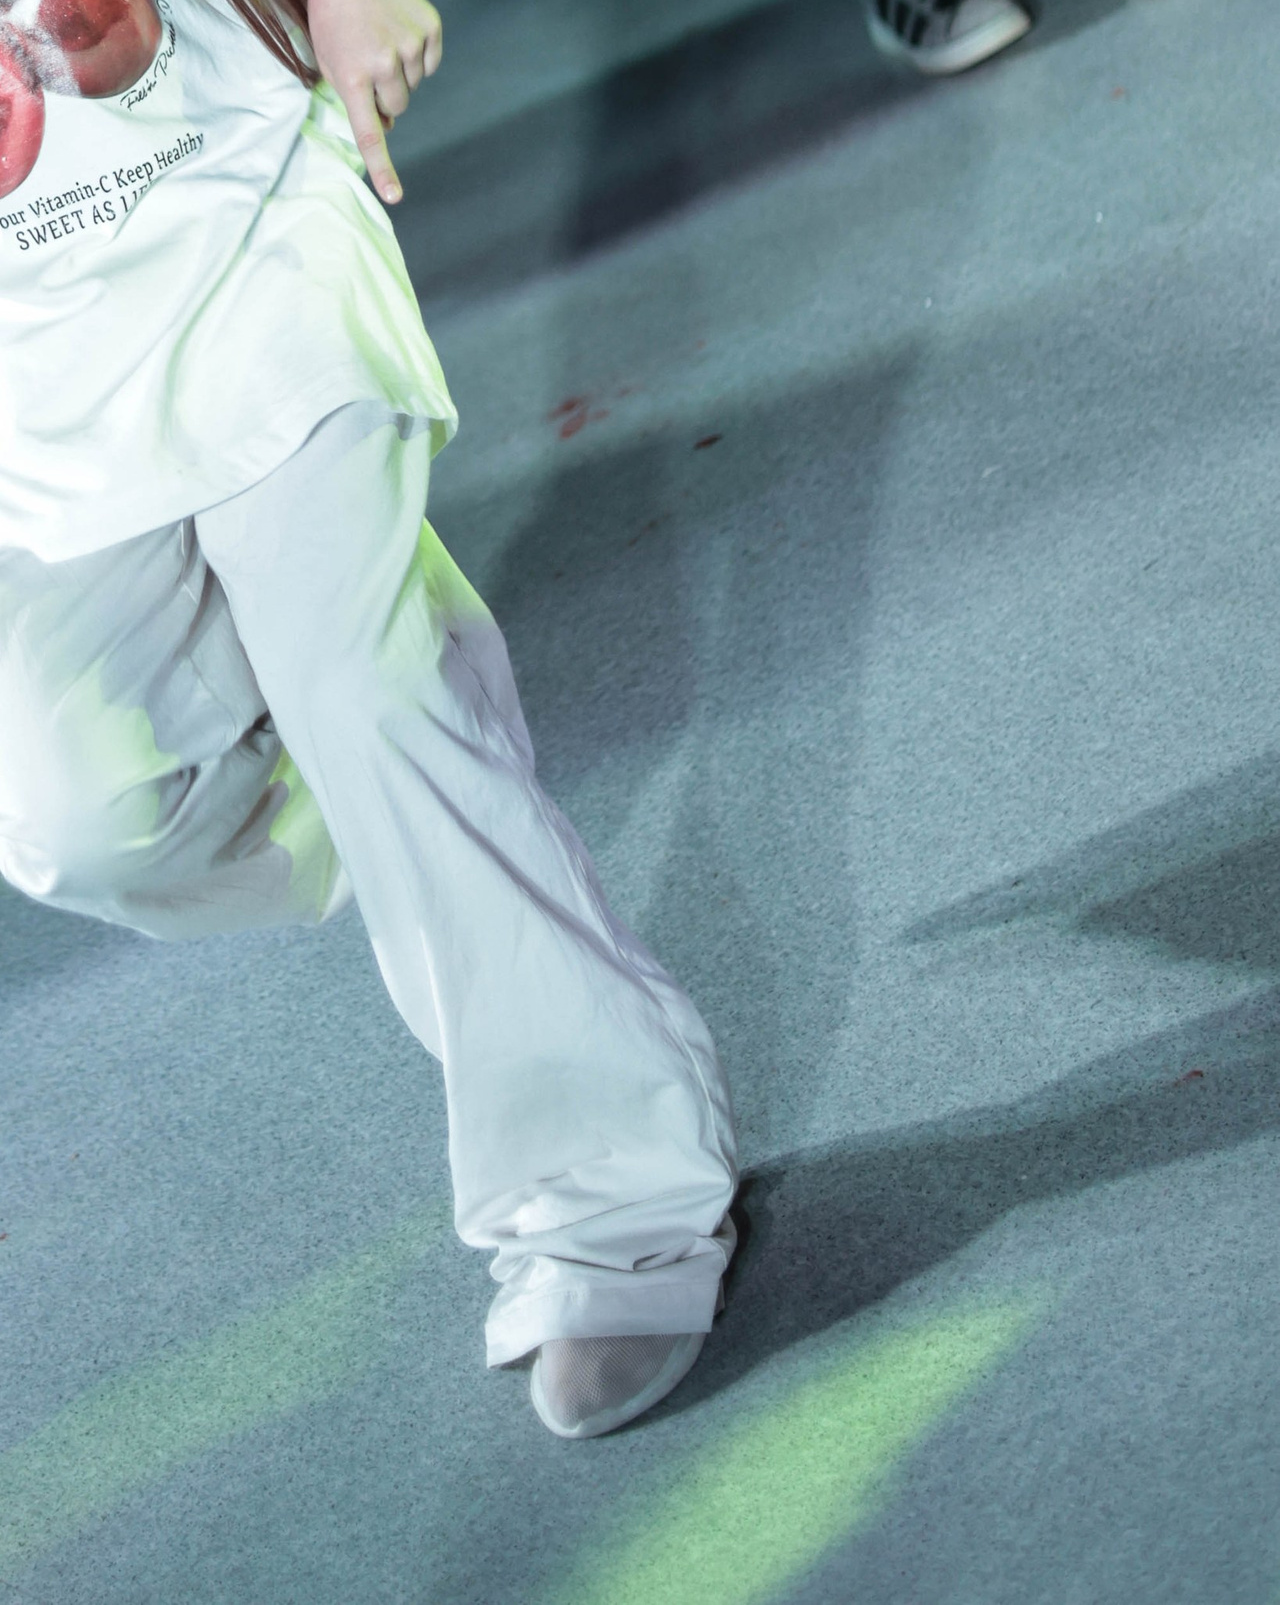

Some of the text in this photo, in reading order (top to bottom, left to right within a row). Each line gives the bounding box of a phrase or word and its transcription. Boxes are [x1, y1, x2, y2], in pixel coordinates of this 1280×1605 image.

[27, 175, 112, 219] Vitamin-C
[113, 161, 154, 189] Keep
[154, 132, 205, 171] Healthy
[16, 210, 86, 251] SWEET
[92, 200, 117, 225] AS
